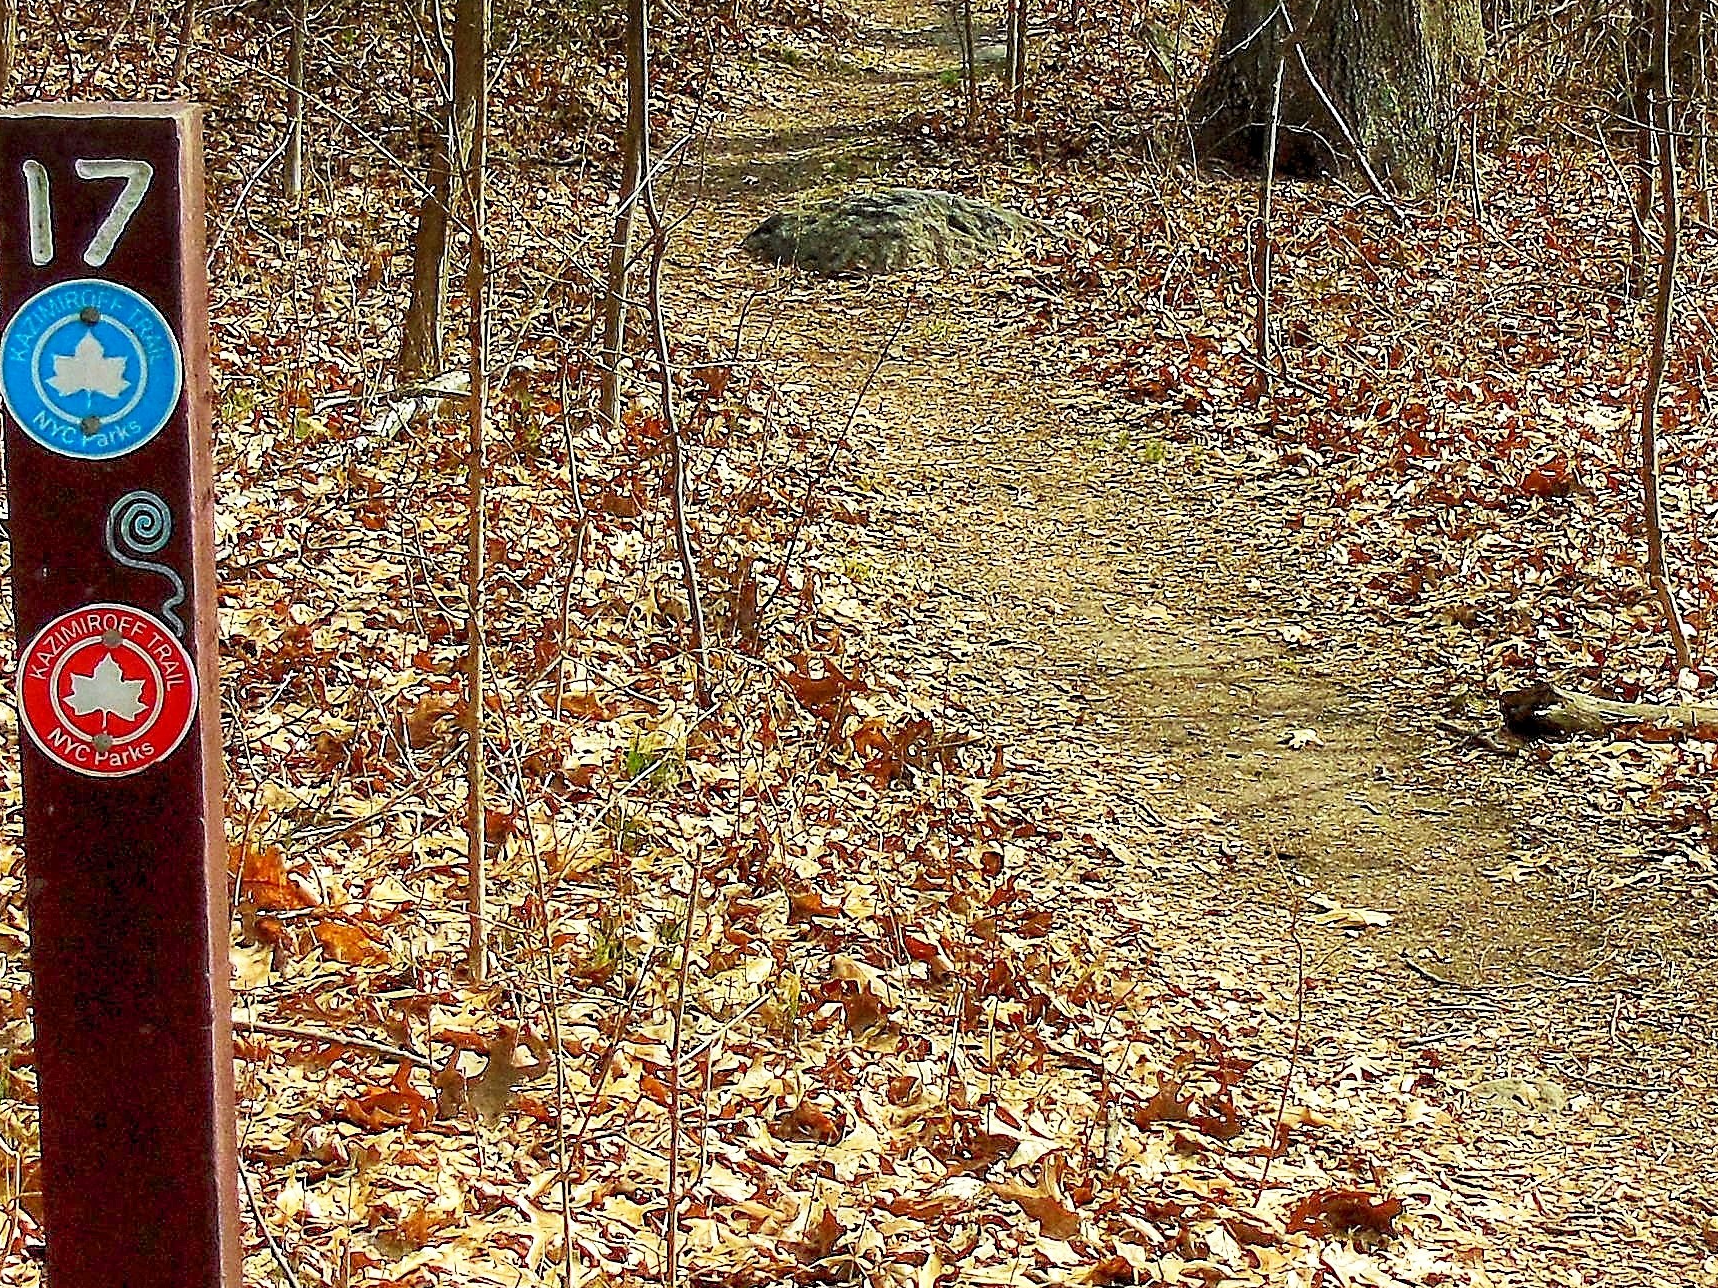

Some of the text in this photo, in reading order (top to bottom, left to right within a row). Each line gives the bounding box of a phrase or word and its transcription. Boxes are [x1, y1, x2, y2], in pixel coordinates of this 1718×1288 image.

[22, 158, 153, 266] 17
[11, 290, 164, 365] KAZIMIROFF TRAIL
[33, 410, 141, 447] NYC Parks
[28, 614, 185, 692] KAZIMIROFF TRAIL
[47, 727, 155, 766] NYC Parks
